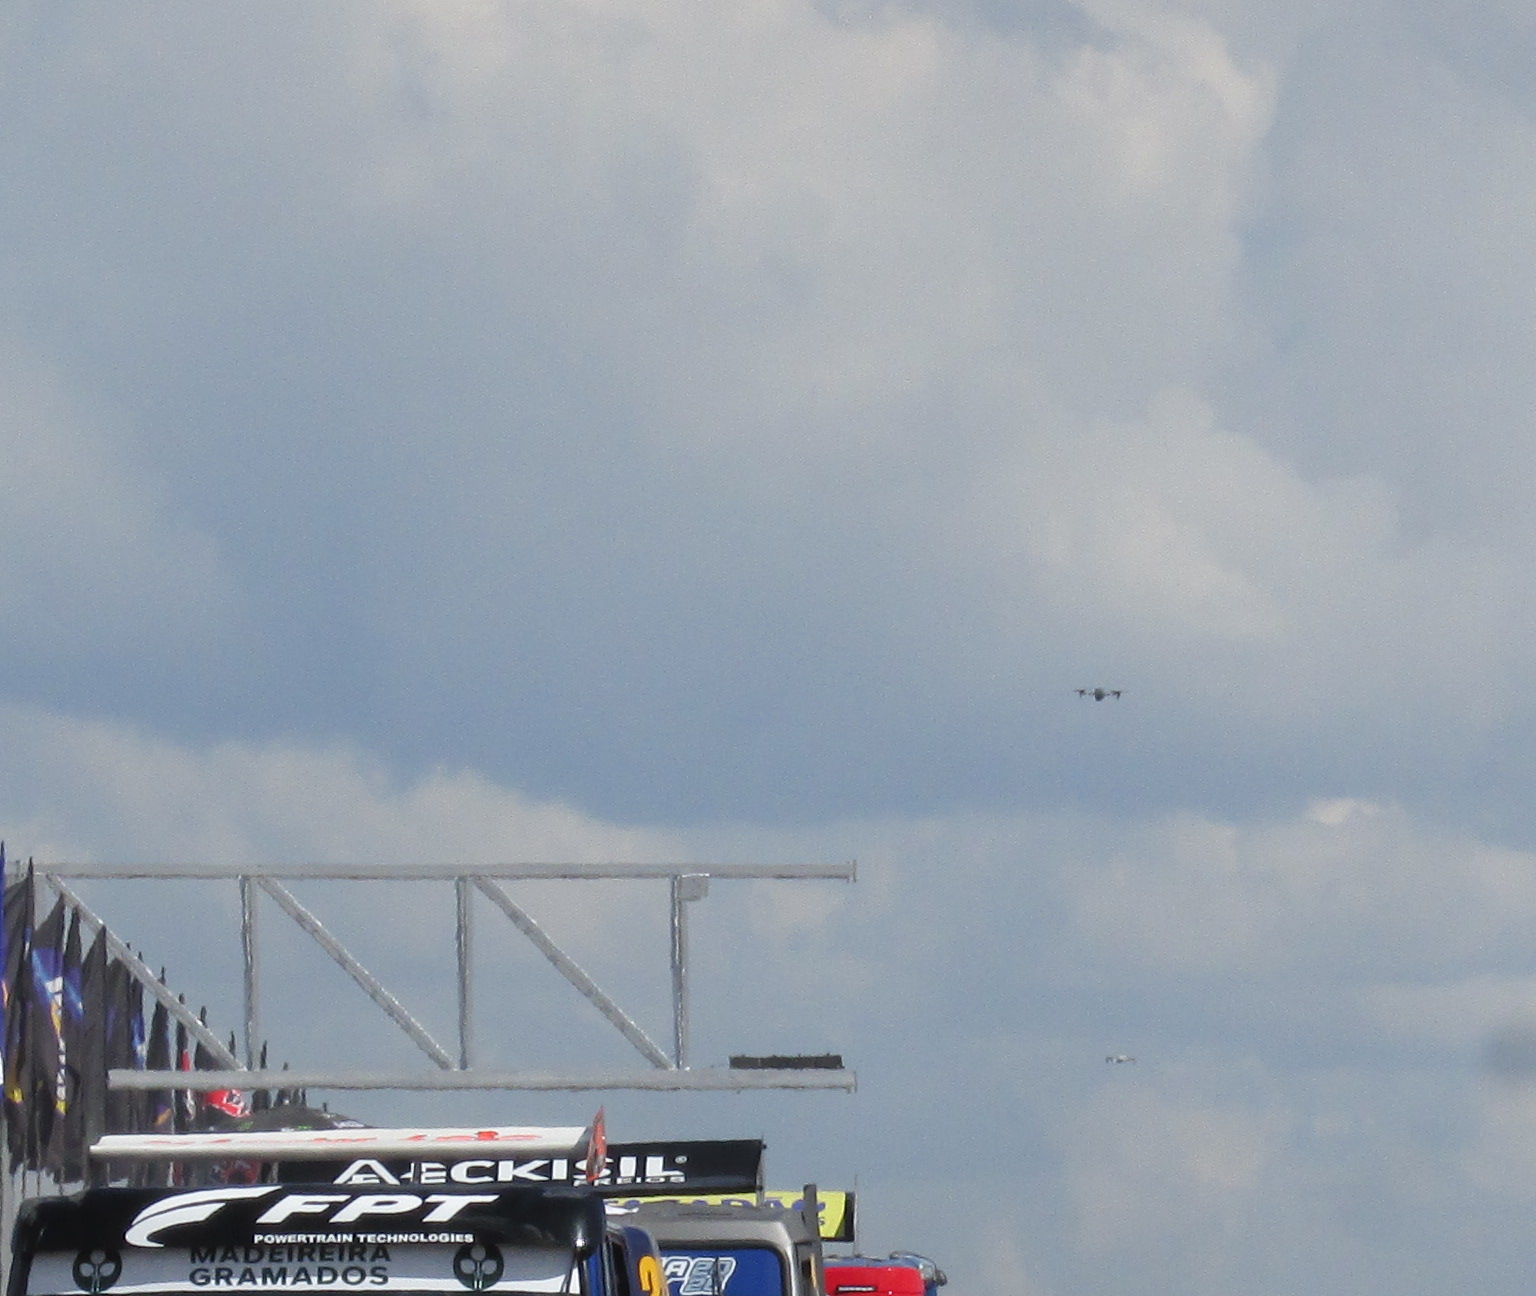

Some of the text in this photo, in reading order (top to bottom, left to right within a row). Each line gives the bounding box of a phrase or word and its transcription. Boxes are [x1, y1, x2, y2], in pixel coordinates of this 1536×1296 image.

[256, 1194, 501, 1224] FPT
[253, 1232, 475, 1245] POWERTRAIN TECHNOLOGIES
[189, 1245, 391, 1263] MADEIREIRA
[189, 1266, 390, 1286] GRAMADOS
